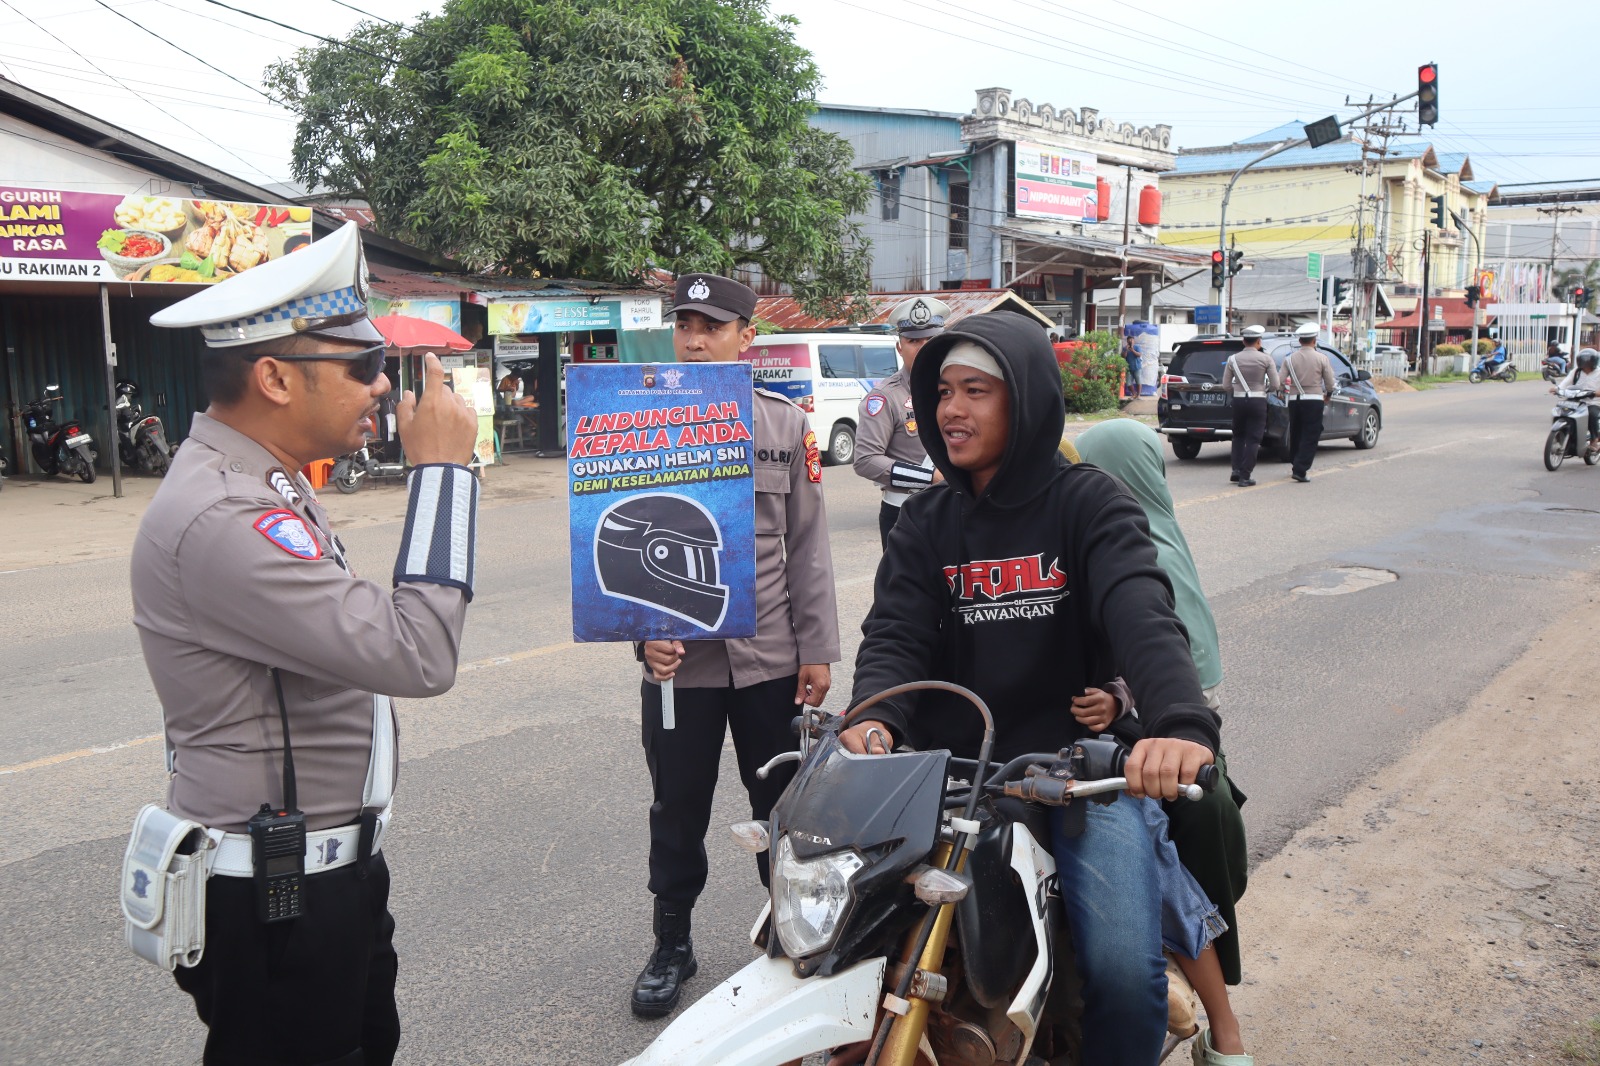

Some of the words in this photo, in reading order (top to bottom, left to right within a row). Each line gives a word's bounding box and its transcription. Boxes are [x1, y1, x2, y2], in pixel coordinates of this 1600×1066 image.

[0, 191, 62, 203] GURIH
[1029, 191, 1060, 205] NIPPON
[1060, 194, 1082, 208] PAINT
[13, 239, 67, 251] RASA
[18, 263, 88, 276] RAKIMAN
[93, 265, 101, 276] 2
[564, 306, 589, 318] ESSE
[762, 357, 791, 366] UNTUK
[574, 401, 740, 435] LINDUNGILAH
[569, 428, 671, 459] KEPALA
[677, 421, 752, 448] ANDA
[572, 454, 661, 477] GUNAKAN
[665, 450, 712, 467] HELM
[717, 446, 745, 461] SNI
[754, 449, 791, 464] OLRI
[573, 479, 608, 493] DEMI
[612, 468, 709, 489] KESELAMATAN
[712, 464, 750, 478] ANDA
[963, 603, 1055, 625] KAWANGAN
[793, 830, 832, 846] HONDA
